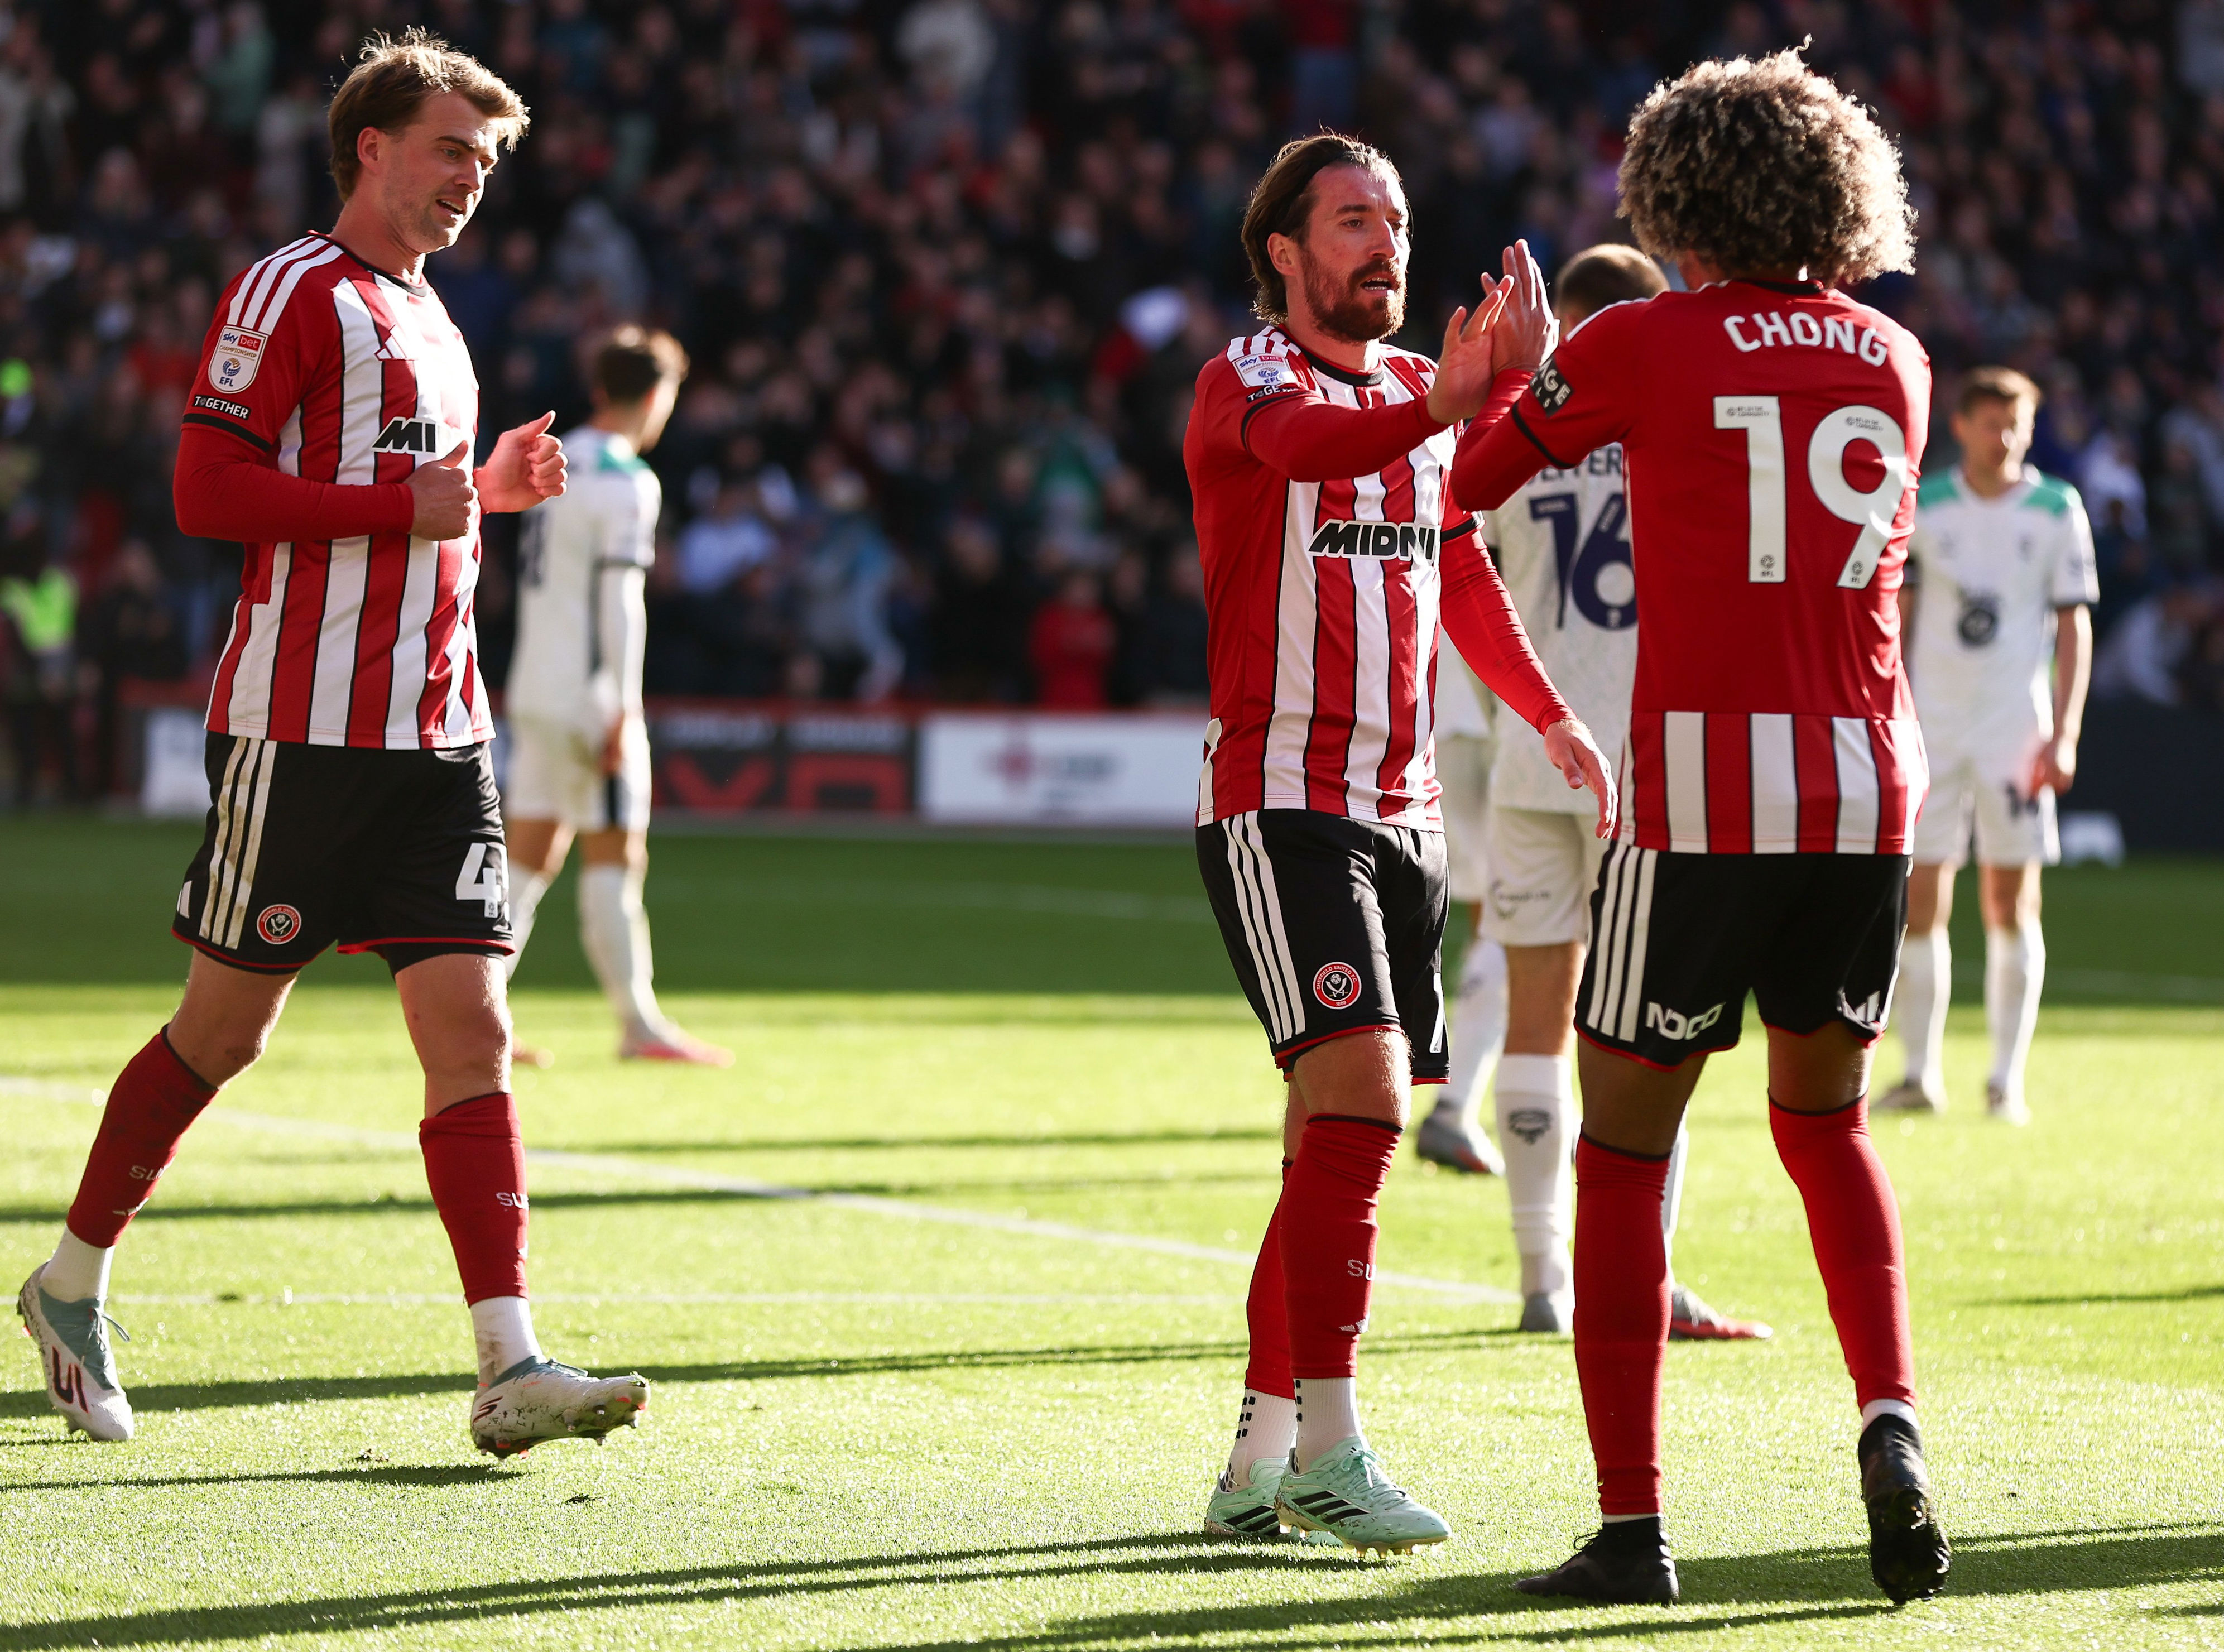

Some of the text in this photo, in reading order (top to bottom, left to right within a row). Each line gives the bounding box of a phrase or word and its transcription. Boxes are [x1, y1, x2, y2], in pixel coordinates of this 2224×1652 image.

[223, 333, 258, 348] sky bet
[1723, 311, 1889, 367] CHONG
[219, 345, 257, 358] CHAMPIONSHIP
[1239, 357, 1257, 368] sky
[219, 376, 233, 387] EFL
[195, 395, 249, 419] TOGETHER
[1713, 395, 1908, 590] 19
[1528, 492, 1639, 631] 16
[1317, 967, 1333, 990] SHEFFIELD
[1334, 966, 1352, 975] UNITED
